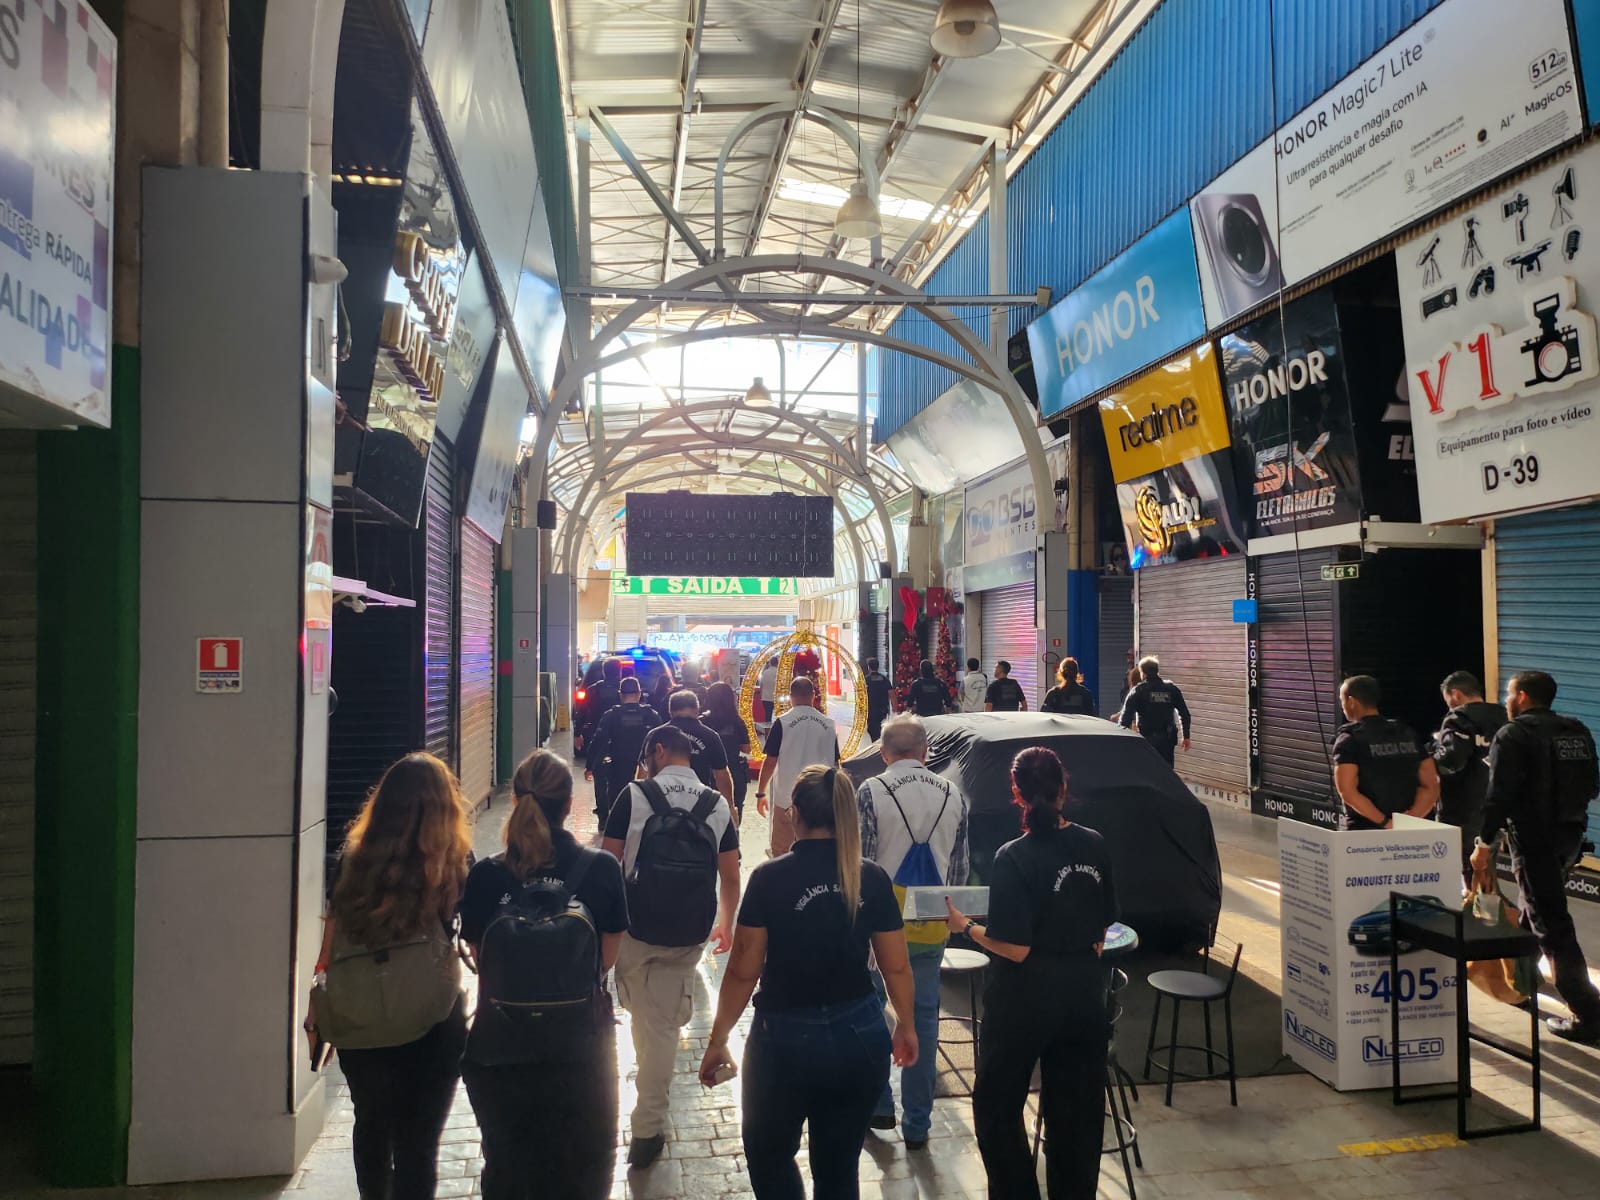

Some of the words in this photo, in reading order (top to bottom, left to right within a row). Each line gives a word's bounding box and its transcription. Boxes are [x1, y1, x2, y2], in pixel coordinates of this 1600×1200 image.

[1275, 111, 1328, 160] HONOR
[1390, 43, 1424, 79] Lite
[1524, 80, 1573, 116] MagicOS
[1286, 135, 1352, 185] Ultrarresistência
[1353, 129, 1360, 140] e
[1361, 108, 1391, 135] magia
[1392, 92, 1415, 113] com
[1416, 80, 1428, 97] IA
[1308, 169, 1328, 191] para
[1328, 143, 1367, 175] qualquer
[1368, 118, 1404, 149] desafio
[45, 231, 92, 285] RÁPIDA
[1055, 274, 1161, 378] HONOR
[1233, 350, 1329, 412] HONOR
[1119, 396, 1198, 451] realme
[1440, 430, 1500, 455] Equipamento
[1502, 424, 1524, 441] para
[1526, 416, 1548, 432] foto
[1551, 416, 1558, 425] e
[1560, 405, 1592, 424] vídeo
[1249, 639, 1257, 688] HONOR
[1251, 708, 1259, 757] HONOR
[1264, 798, 1294, 815] HONOR
[1385, 843, 1430, 853] Volkswagen
[1393, 852, 1430, 861] Embracon
[1345, 874, 1393, 888] CONQUISTE
[1394, 873, 1411, 885] SEU
[1412, 871, 1440, 883] CARRO
[1370, 967, 1439, 1004] 405
